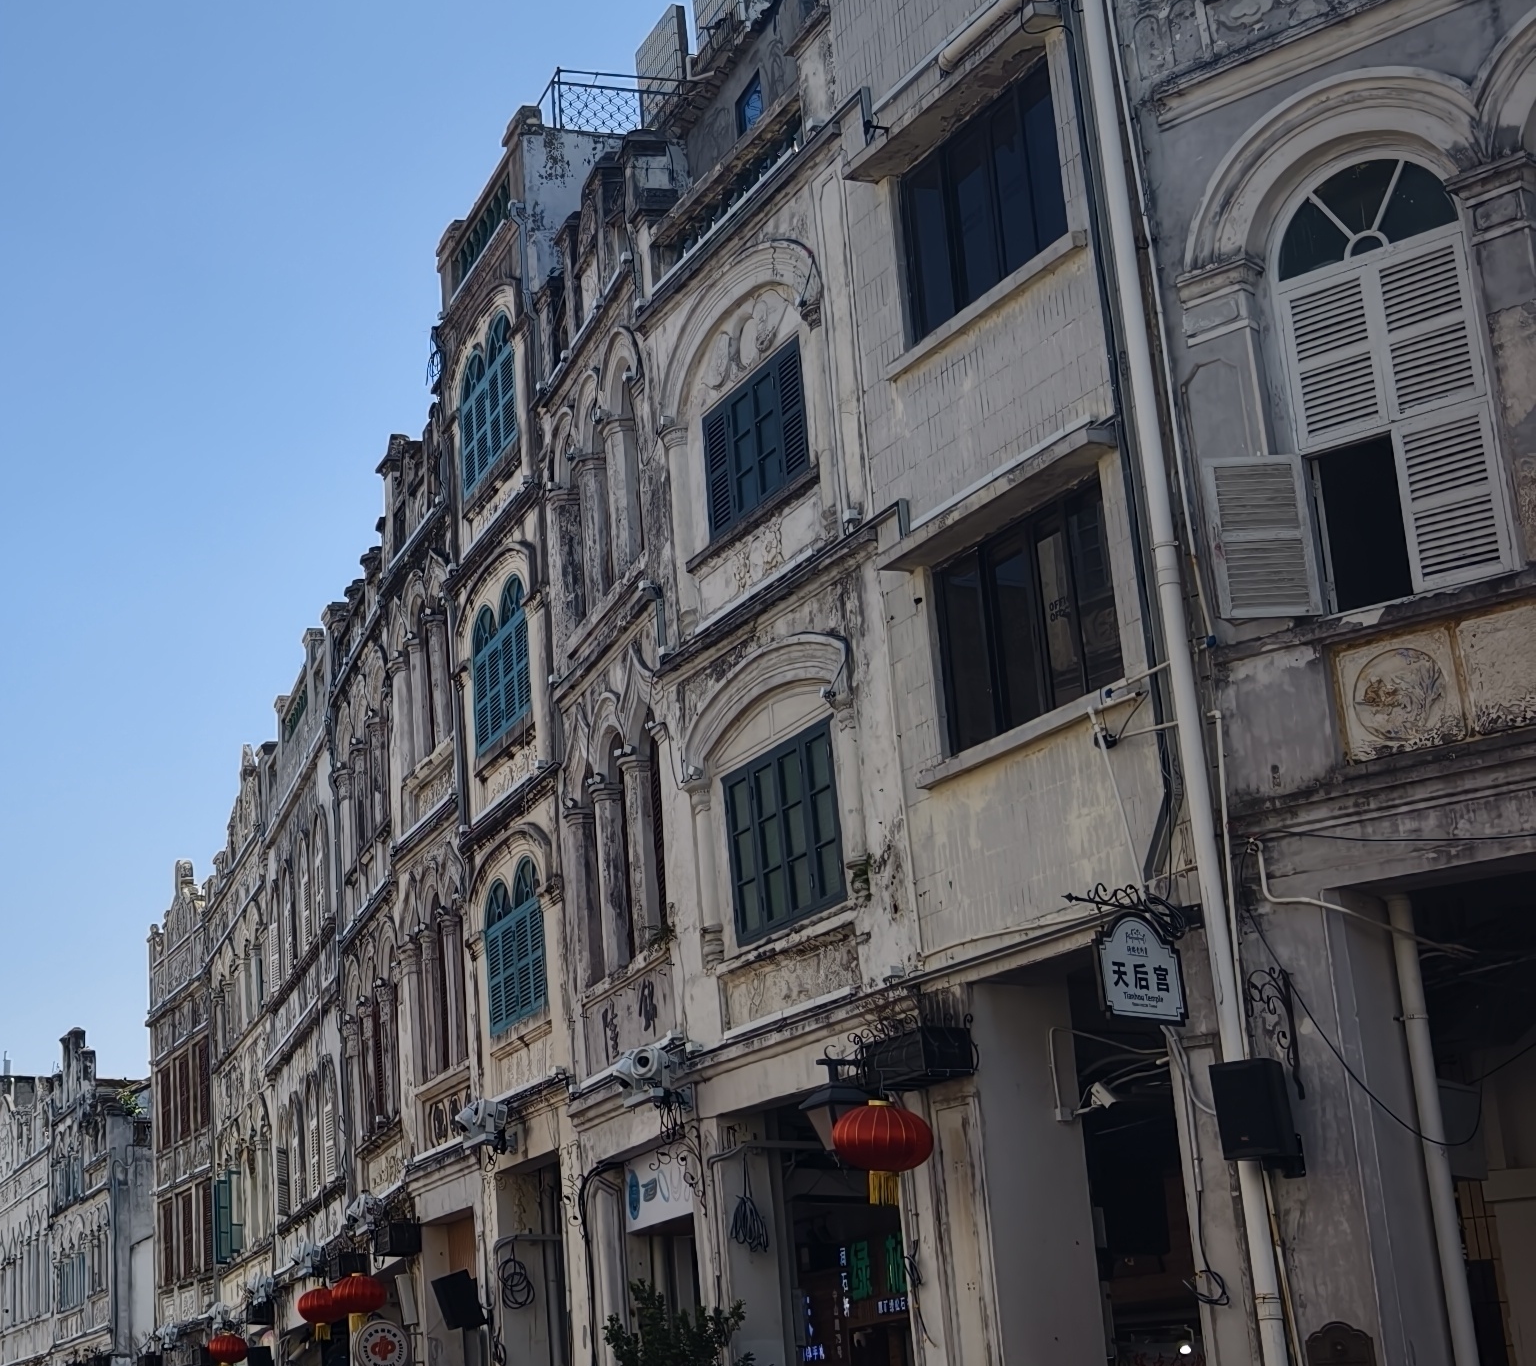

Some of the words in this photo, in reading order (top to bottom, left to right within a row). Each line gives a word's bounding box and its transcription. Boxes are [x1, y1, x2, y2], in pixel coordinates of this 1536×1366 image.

[1112, 961, 1170, 993] 天后宫
[1123, 992, 1145, 1001] Tianhou
[1145, 994, 1164, 1003] Temple
